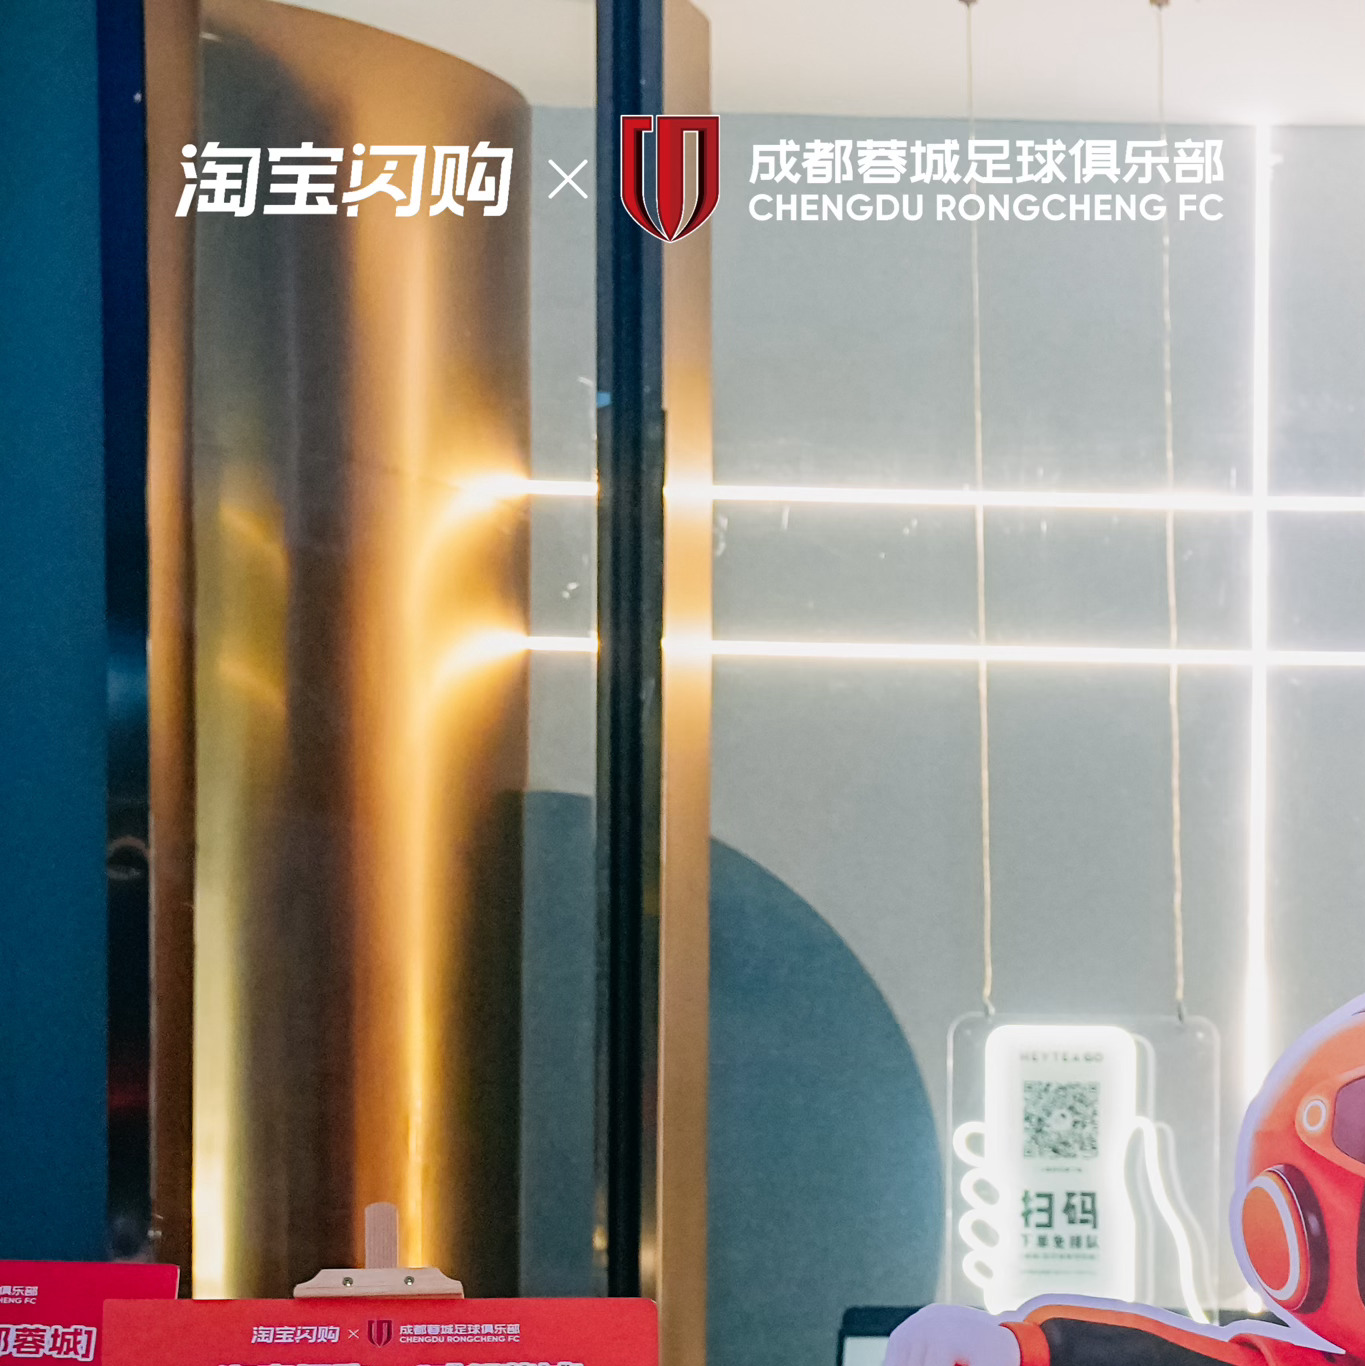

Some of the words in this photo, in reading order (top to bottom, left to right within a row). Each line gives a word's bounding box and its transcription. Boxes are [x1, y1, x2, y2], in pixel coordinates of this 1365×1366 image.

[1021, 1190, 1098, 1230] 扫码
[251, 1326, 340, 1343] 淘宝闪购
[399, 1324, 520, 1335] 成都蓉城足球俱乐部
[399, 1335, 445, 1343] CHENGDU
[447, 1335, 506, 1343] RONGCHENG
[507, 1335, 520, 1343] FC
